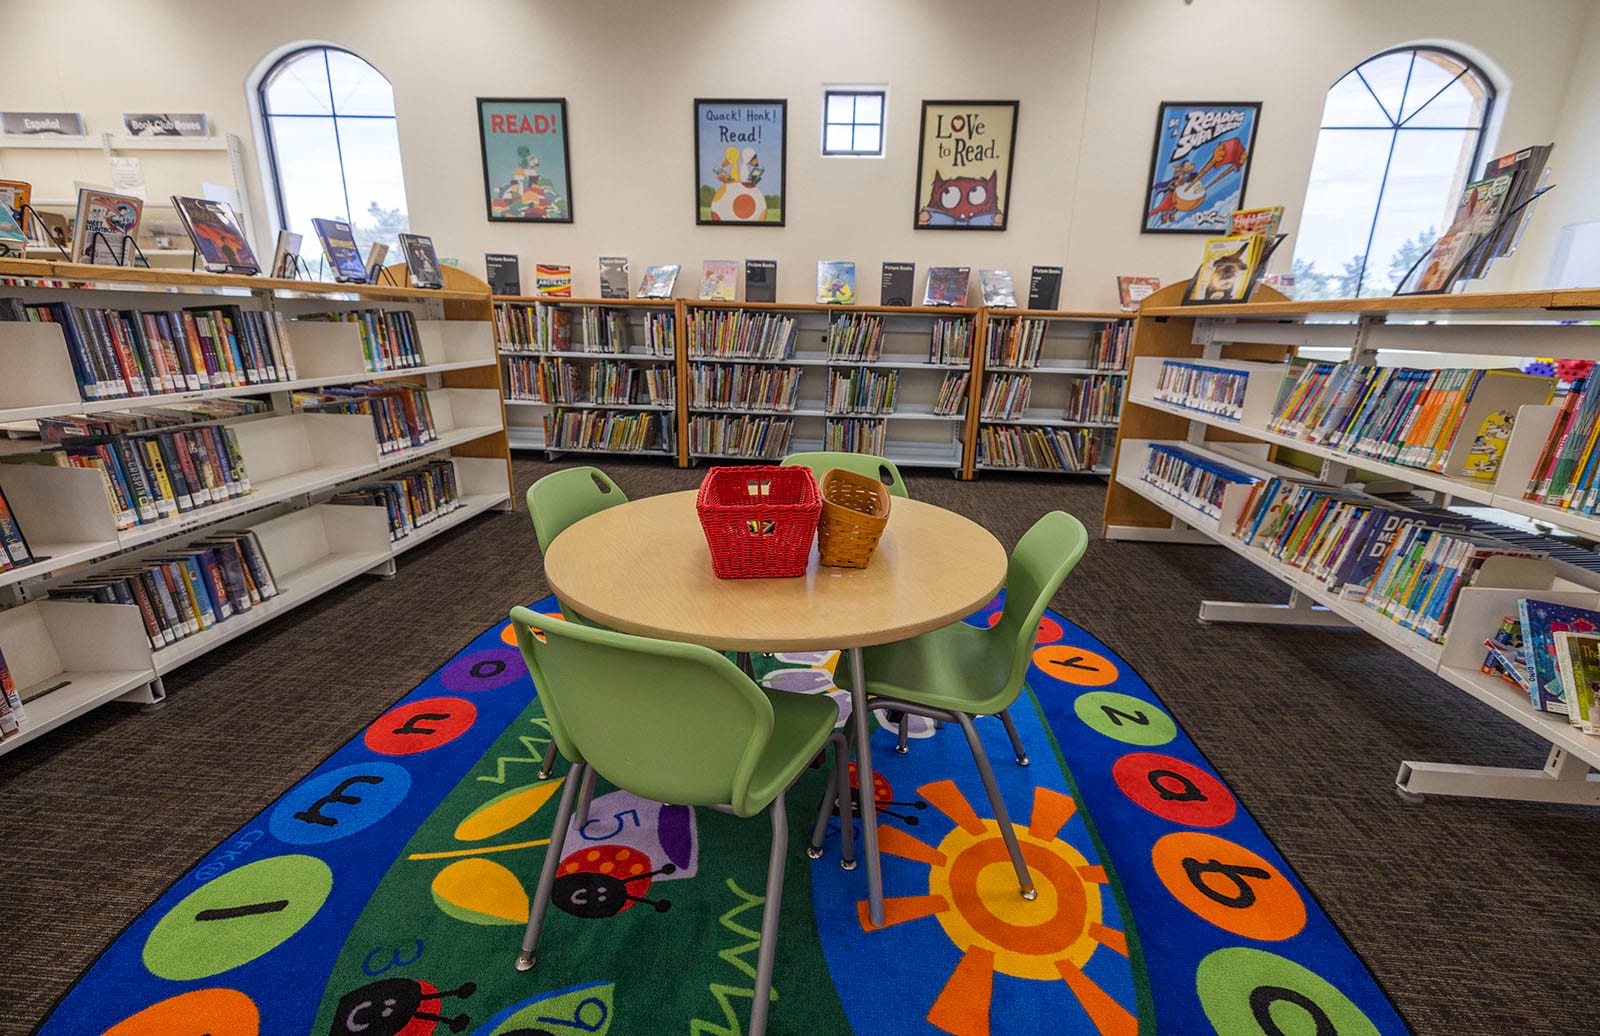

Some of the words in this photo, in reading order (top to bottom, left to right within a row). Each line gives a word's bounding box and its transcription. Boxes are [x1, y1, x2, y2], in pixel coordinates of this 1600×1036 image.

[24, 117, 61, 130] Español
[132, 119, 153, 131] Book
[154, 119, 174, 130] Club
[174, 120, 201, 131] Boxes
[491, 113, 557, 135] READ!
[706, 109, 742, 123] Quack!
[747, 109, 777, 123] Honk!
[719, 125, 762, 144] Read!
[939, 142, 951, 159] to
[952, 138, 1000, 167] Read.
[127, 458, 146, 498] CRISPIN
[1527, 666, 1536, 682] DINO
[582, 809, 642, 843] 5
[362, 939, 425, 976] 3
